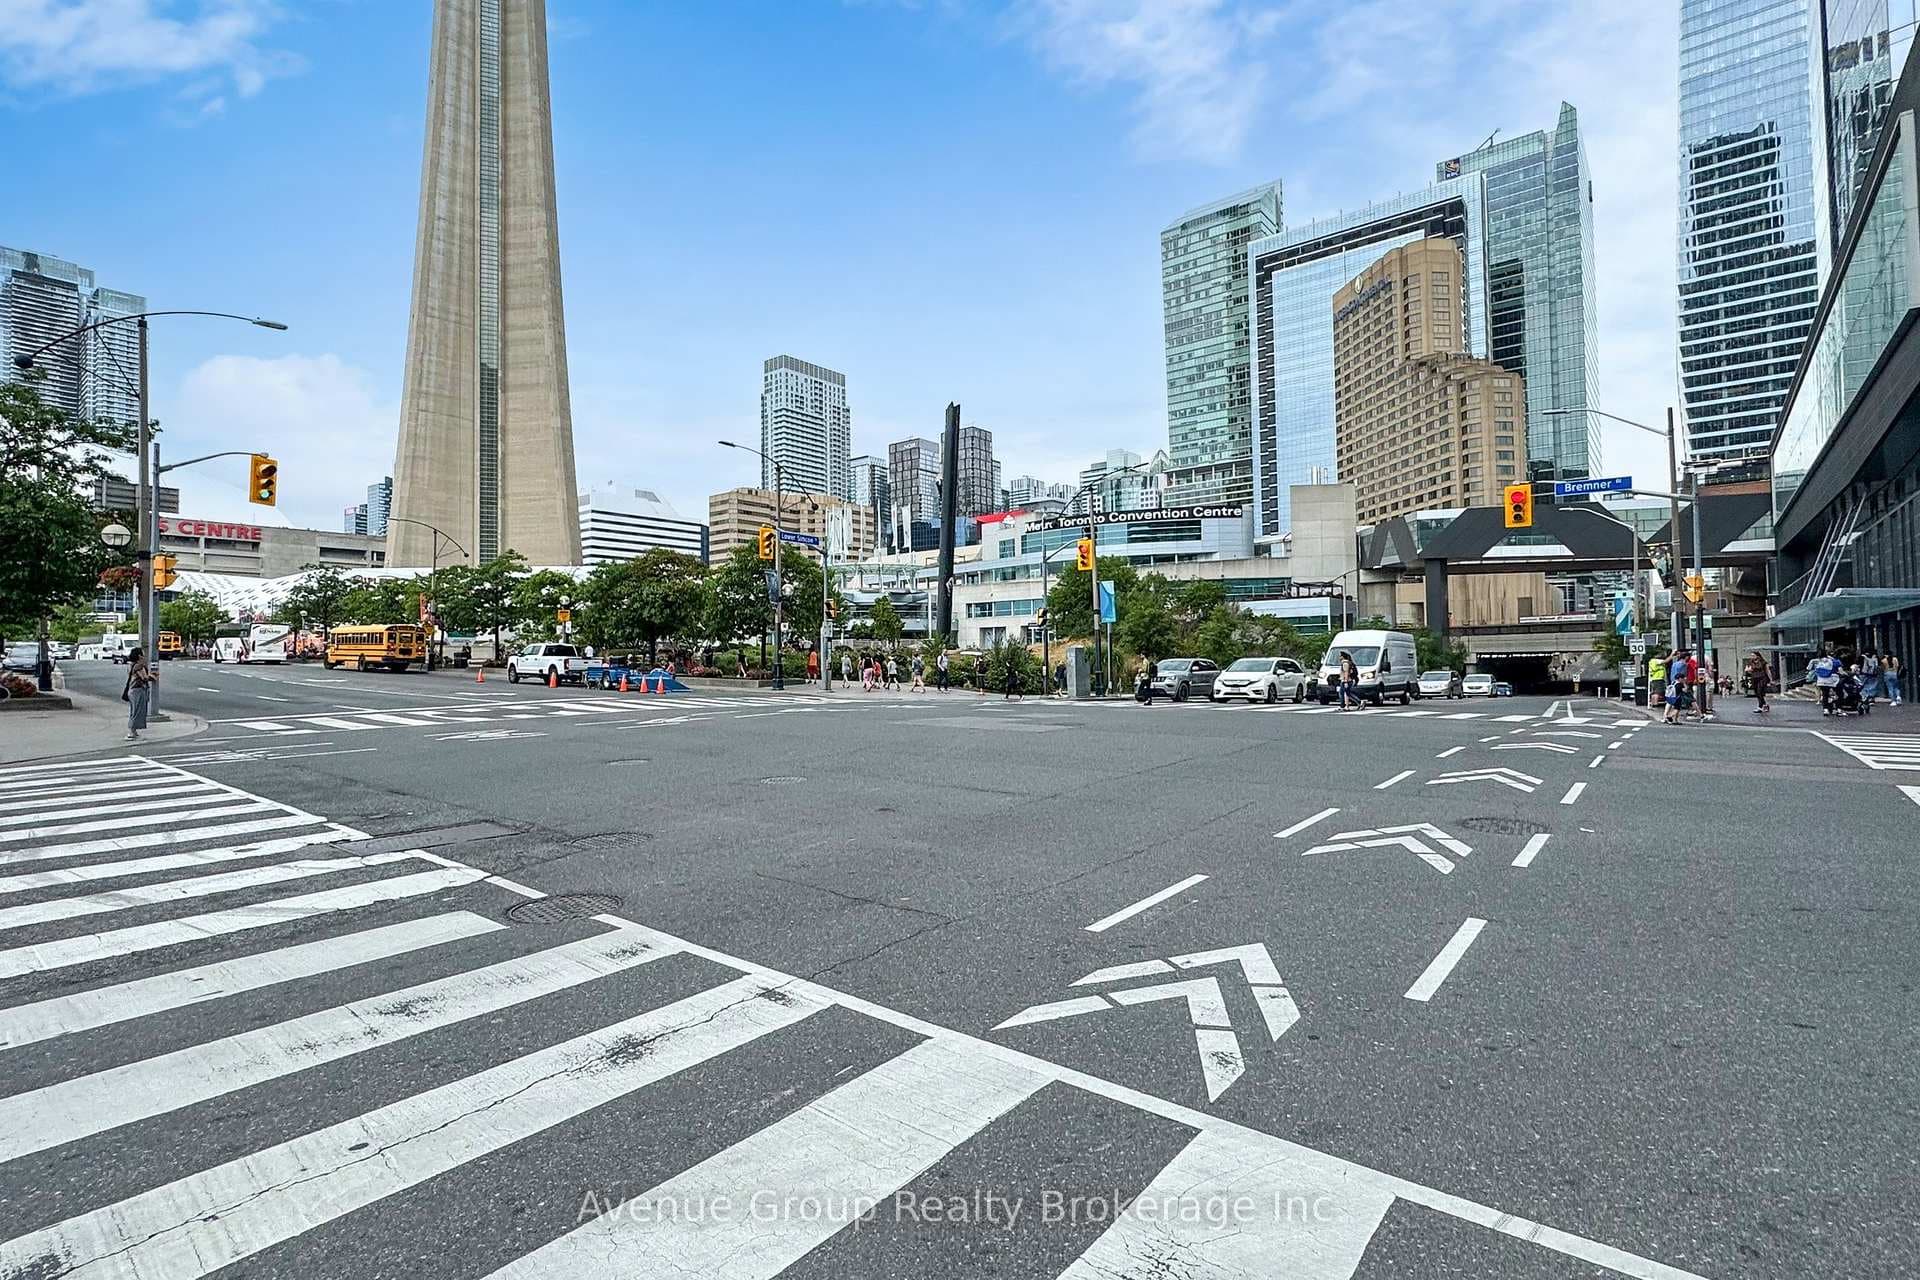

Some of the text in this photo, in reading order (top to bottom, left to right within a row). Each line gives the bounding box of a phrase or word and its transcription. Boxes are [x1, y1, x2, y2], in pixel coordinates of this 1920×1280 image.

[1564, 480, 1612, 493] Bremner
[1057, 514, 1106, 528] Toronto
[1109, 507, 1189, 522] Convention
[1193, 506, 1242, 518] Centre
[177, 520, 262, 541] CENTRE
[1631, 645, 1644, 653] 30
